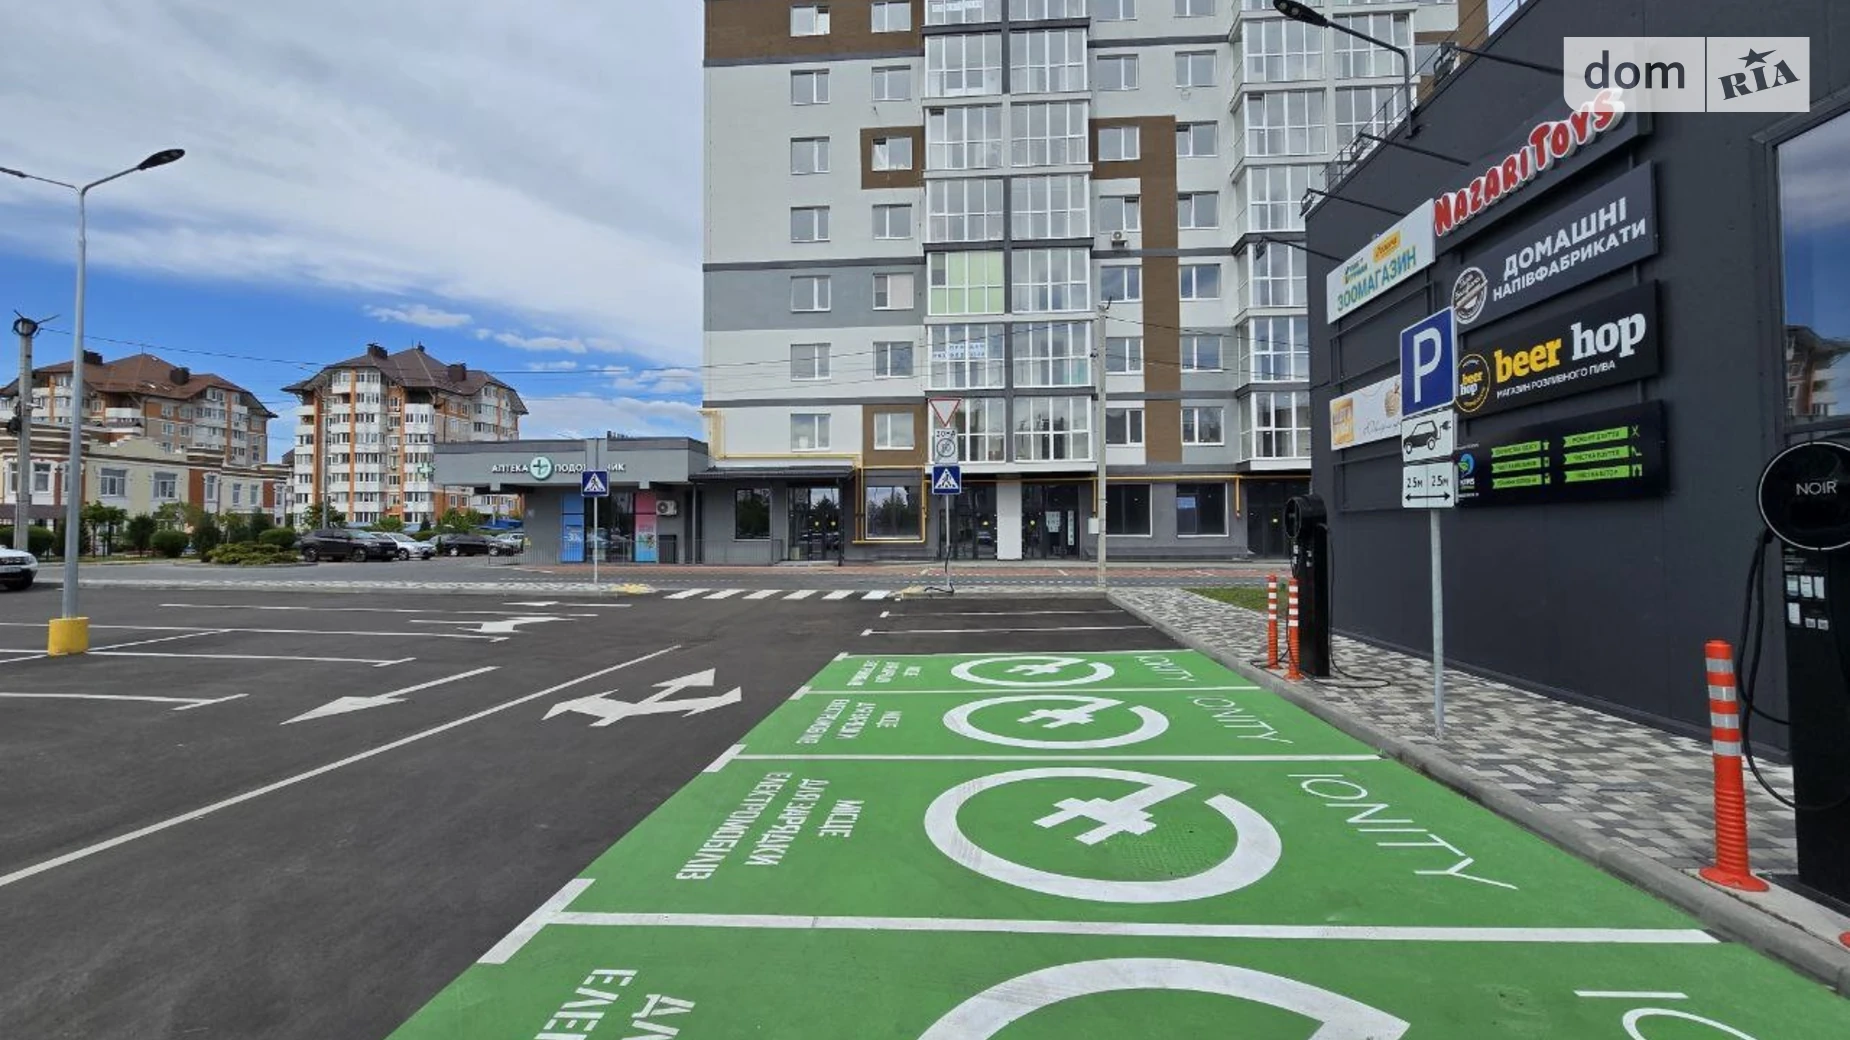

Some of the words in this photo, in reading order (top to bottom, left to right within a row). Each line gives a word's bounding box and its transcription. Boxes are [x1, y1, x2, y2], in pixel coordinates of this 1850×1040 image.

[1492, 218, 1646, 301] НАПІВФАБРИКАТИ
[1503, 196, 1627, 282] ДОМАШНІ
[1337, 245, 1417, 312] ЗООМАГАЗИН
[1413, 327, 1442, 403] P
[1494, 337, 1562, 384] beer
[1570, 313, 1647, 361] hop
[1459, 383, 1478, 396] hop
[1462, 371, 1483, 386] beer
[1496, 382, 1531, 399] МАГАЗИН
[1531, 366, 1588, 390] РОЗЛИВНОГО
[1589, 360, 1616, 376] ПИВА
[491, 463, 529, 474] АПТЕКА
[1796, 481, 1838, 496] NOIR
[1186, 695, 1295, 744] IONITY
[791, 778, 830, 801] ДЛЯ
[675, 771, 793, 880] ЕЛЕКТРОМОБІЛІВ
[743, 802, 815, 866] ЗАРЯДКИ
[818, 799, 865, 838] МІСЦЕ
[1287, 773, 1519, 890] IONITY
